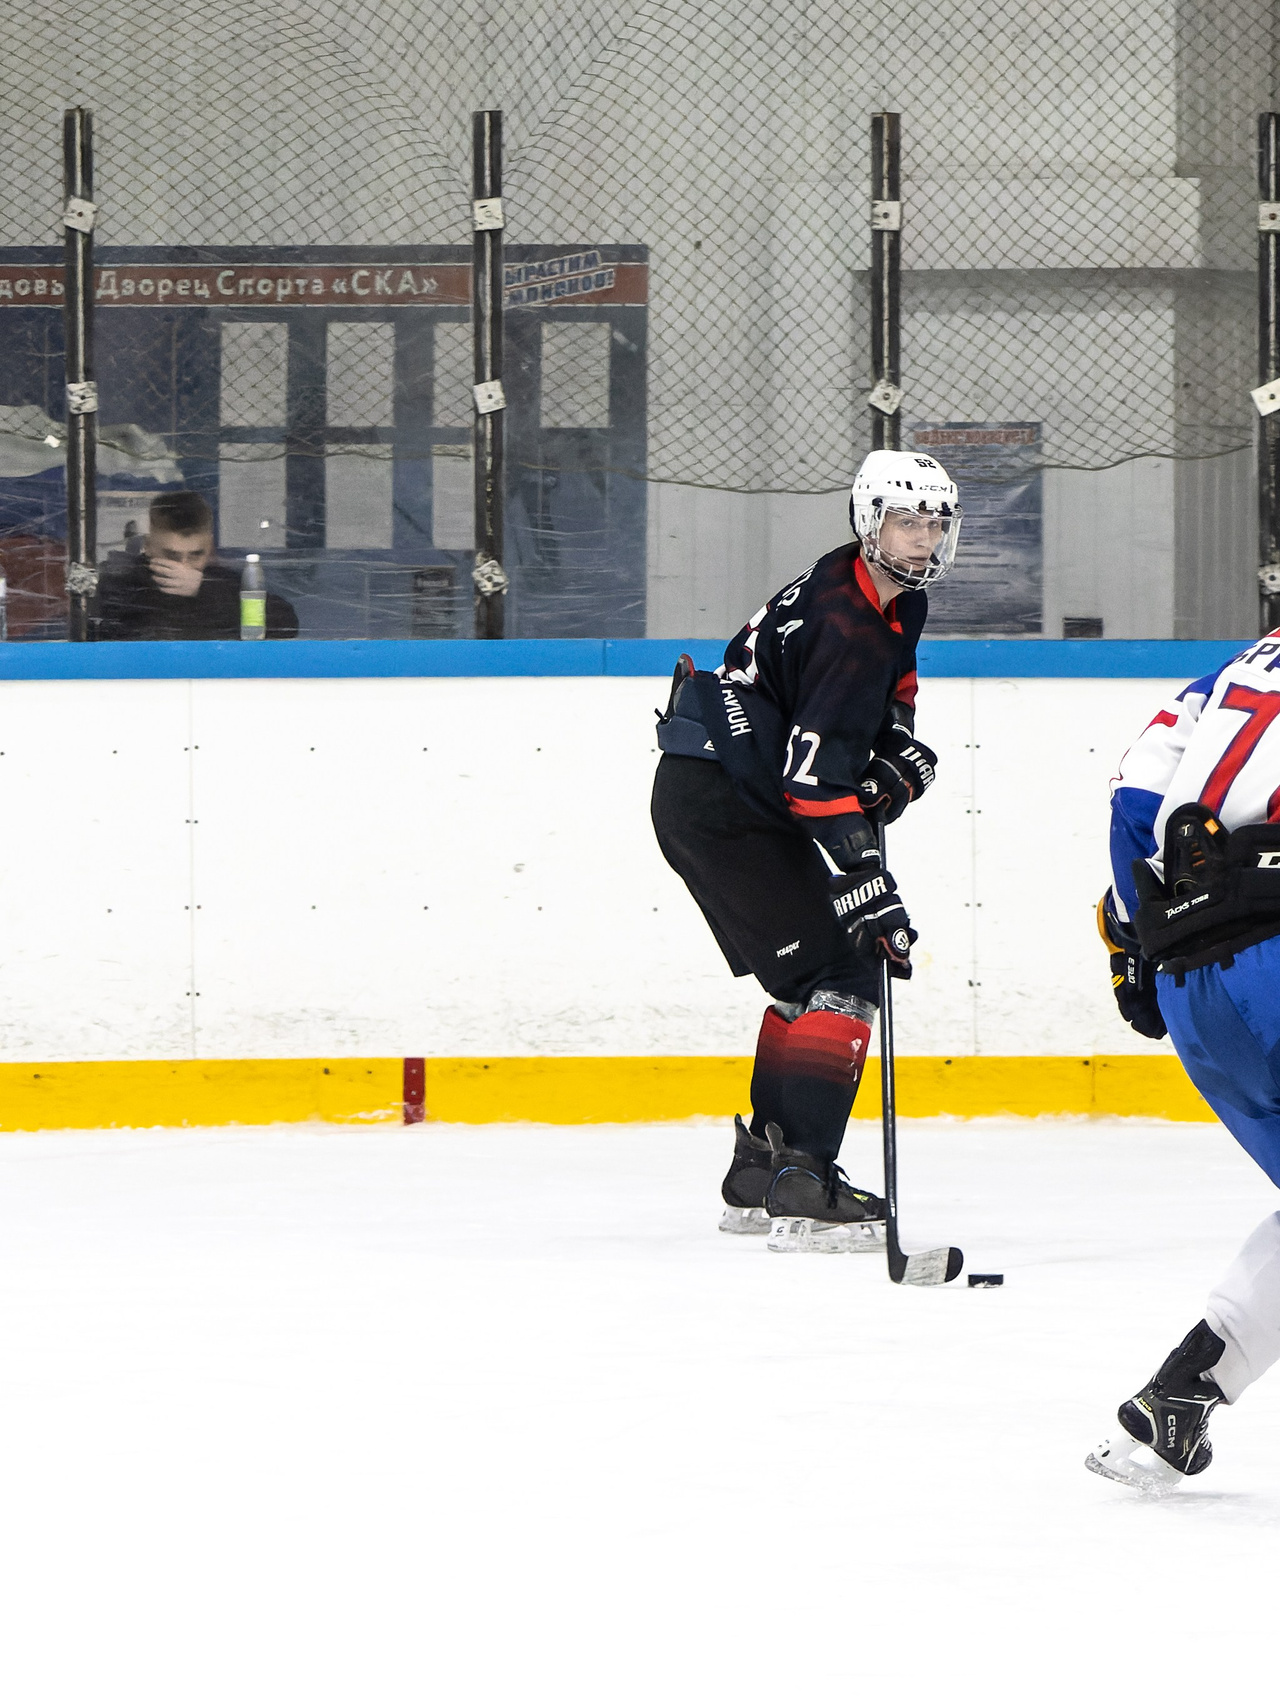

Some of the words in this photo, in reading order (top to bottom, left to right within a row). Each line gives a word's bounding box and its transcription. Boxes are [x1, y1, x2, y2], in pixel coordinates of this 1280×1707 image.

[95, 269, 210, 302] Дворец
[215, 269, 326, 302] Спорта
[331, 269, 439, 296] «СКА»
[914, 458, 937, 469] 52
[1167, 1414, 1176, 1449] CCM
